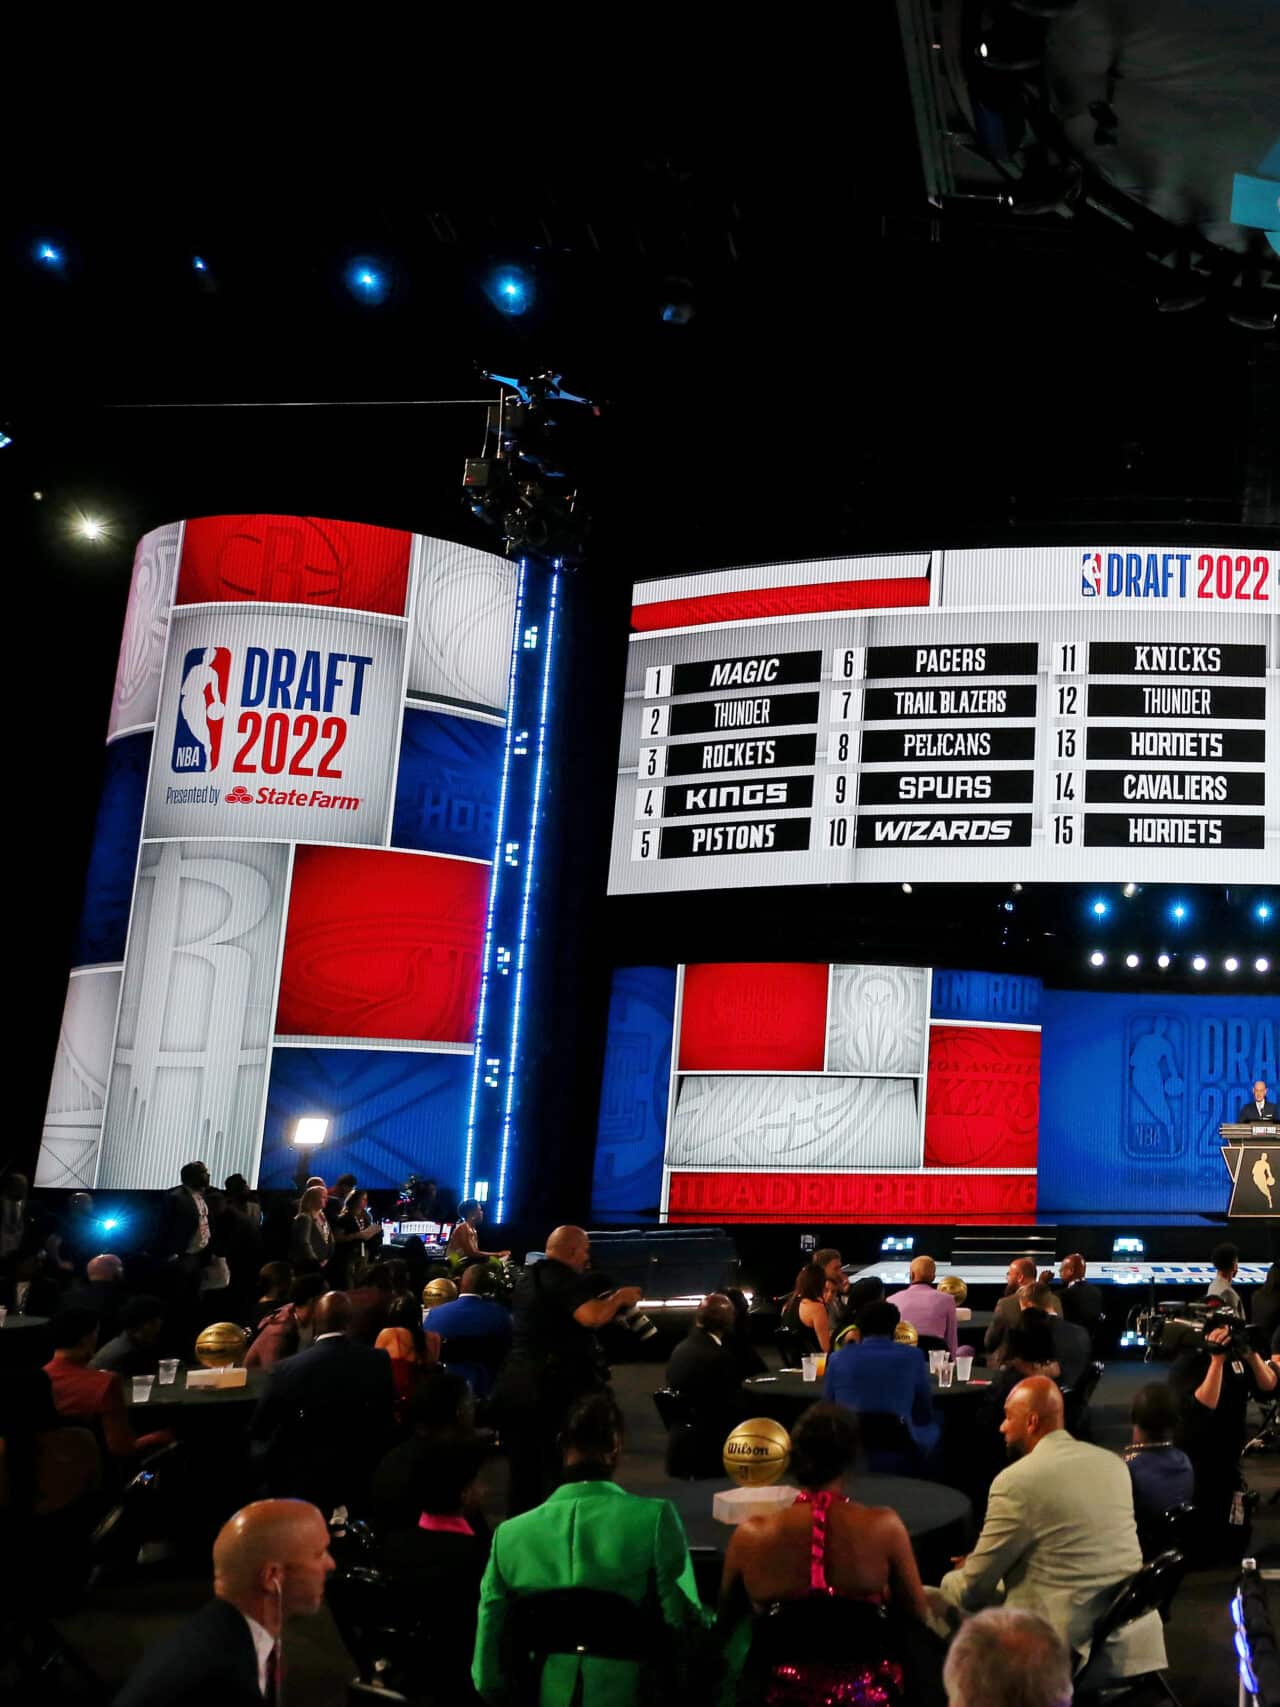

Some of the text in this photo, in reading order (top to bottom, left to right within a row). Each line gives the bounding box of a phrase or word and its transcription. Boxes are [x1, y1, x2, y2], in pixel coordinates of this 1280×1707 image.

[1107, 553, 1191, 598] DRAFT
[1197, 554, 1269, 600] 2022
[843, 647, 986, 678] 6 PACERS
[1061, 644, 1221, 672] 11 KNICKS
[240, 646, 373, 716] DRAFT
[655, 658, 780, 695] 1 MAGIC
[840, 689, 1007, 719] 7 TRAIL BLAZERS
[1058, 686, 1211, 715] 12 THUNDER
[650, 698, 771, 736] 2 THUNDER
[176, 747, 200, 768] NBA
[232, 710, 347, 779] 2022
[838, 732, 991, 762] 8 PELICANS
[1057, 728, 1223, 758] 13 HORNETS
[646, 740, 776, 777] 3 ROCKETS
[166, 786, 207, 805] Presented
[208, 785, 220, 806] by
[643, 782, 788, 818] 4 KINGS
[834, 775, 992, 803] 9 SPURS
[1055, 772, 1228, 801] 14 CAVALIERS
[640, 823, 777, 858] 5 PISTONS
[830, 818, 1013, 848] 10 WIZARDS
[1054, 815, 1222, 845] 15 HORNETS
[727, 1442, 769, 1456] Wilson
